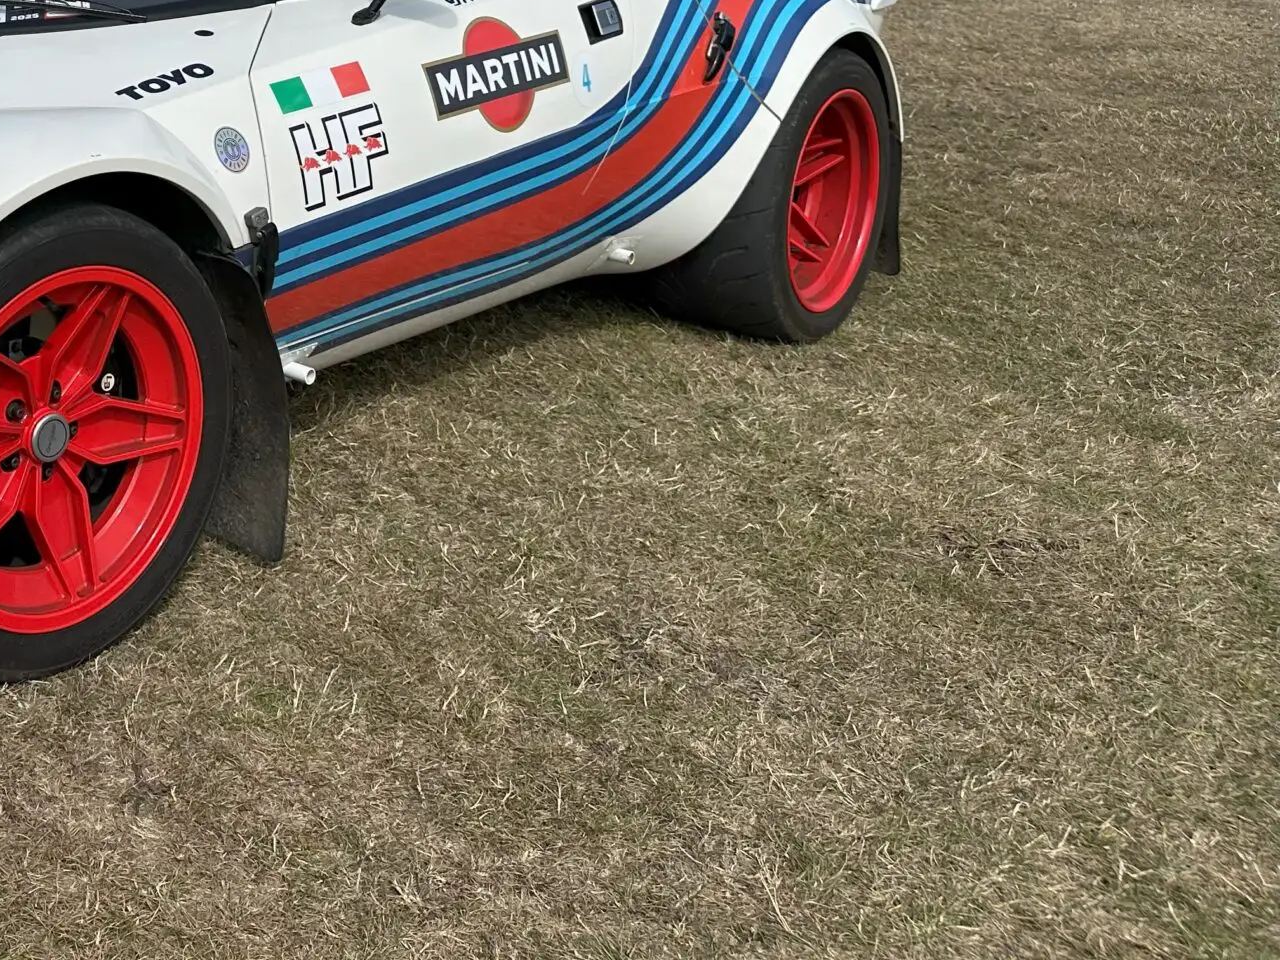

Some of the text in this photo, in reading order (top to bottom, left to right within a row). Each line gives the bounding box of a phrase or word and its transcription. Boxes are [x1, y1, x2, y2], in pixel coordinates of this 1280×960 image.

[115, 63, 214, 101] TOYO
[435, 42, 561, 106] MARTINI
[582, 63, 591, 92] 4
[289, 102, 389, 212] HF
